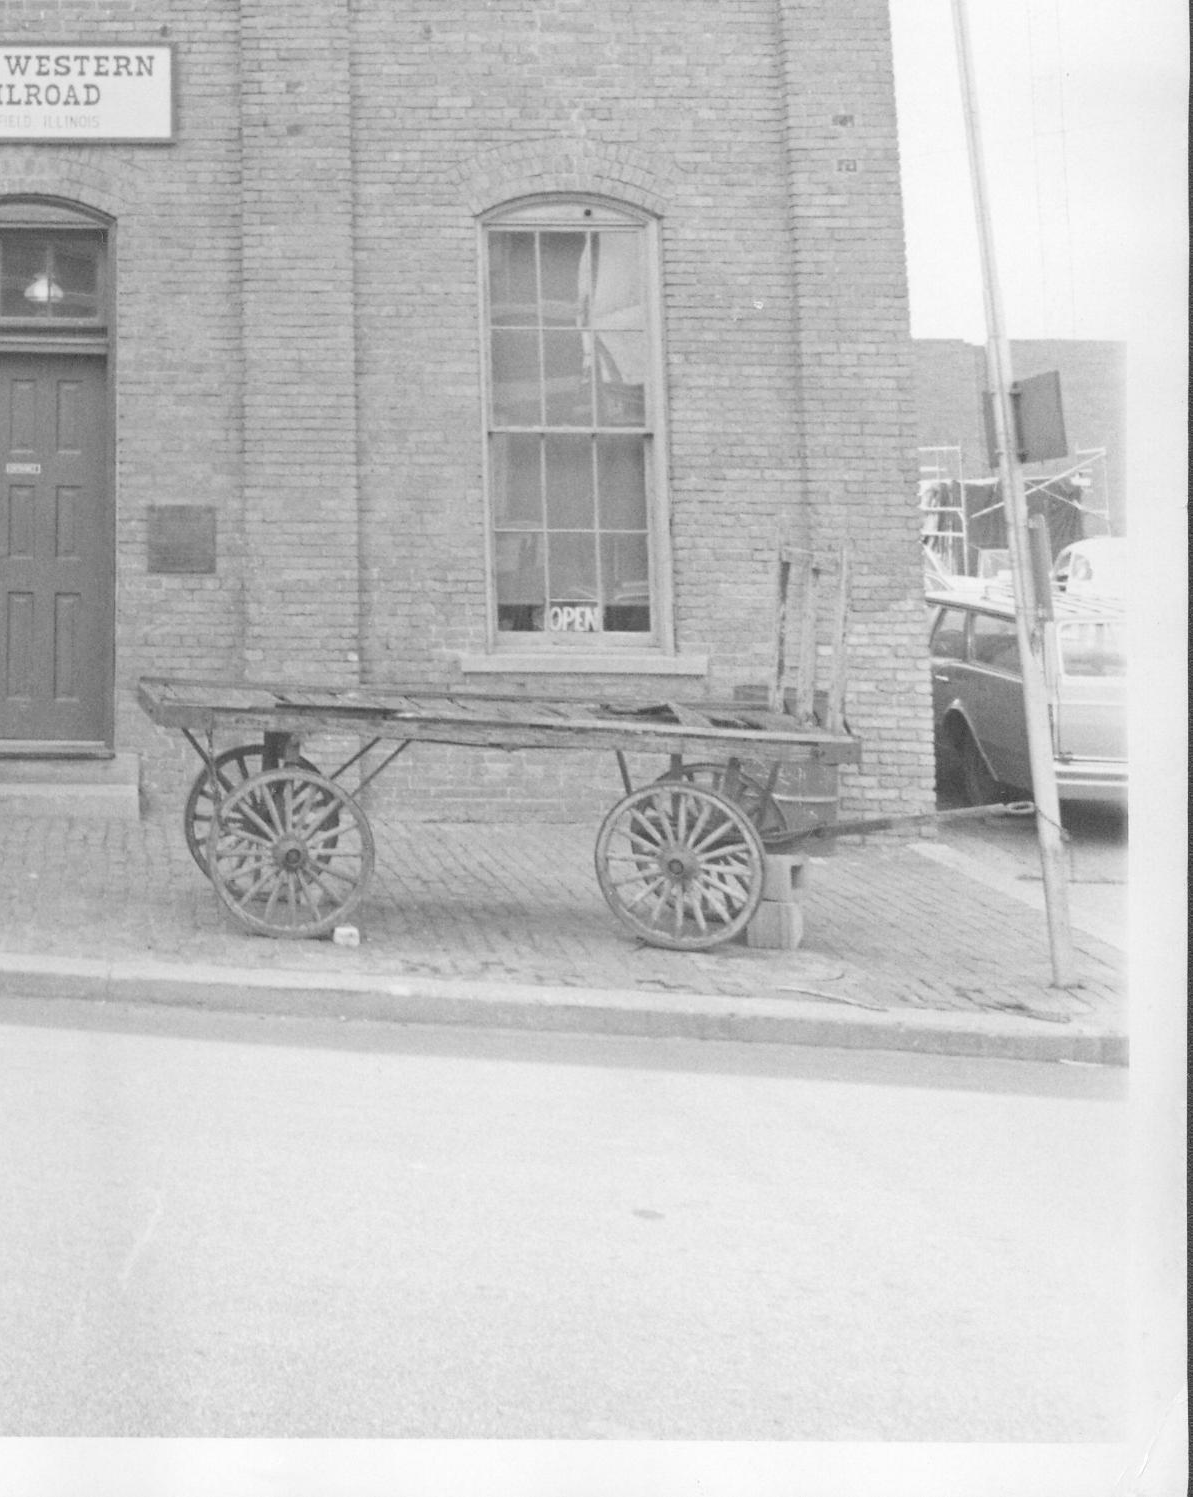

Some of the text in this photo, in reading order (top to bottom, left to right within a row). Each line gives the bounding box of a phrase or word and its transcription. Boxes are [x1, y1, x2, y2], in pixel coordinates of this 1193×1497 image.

[4, 54, 154, 78] WESTERN
[43, 114, 100, 129] ILLINOIS
[550, 606, 598, 632] OPEN
